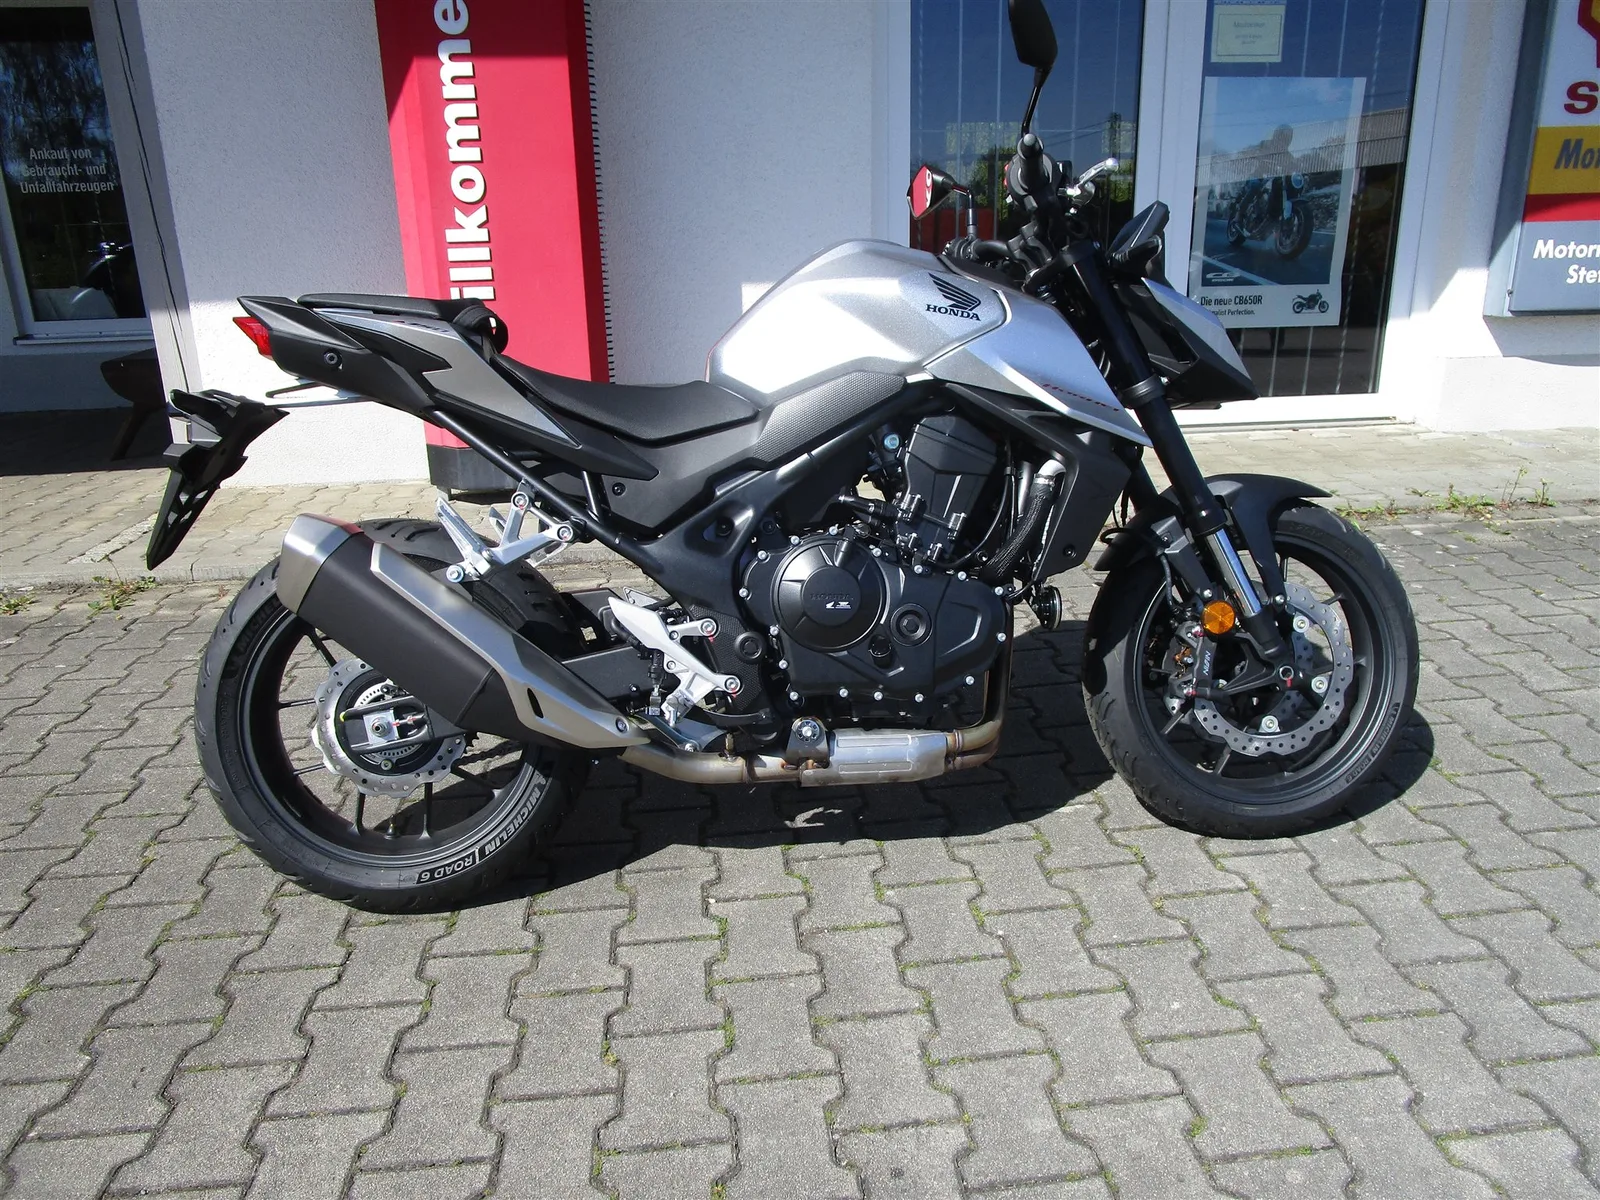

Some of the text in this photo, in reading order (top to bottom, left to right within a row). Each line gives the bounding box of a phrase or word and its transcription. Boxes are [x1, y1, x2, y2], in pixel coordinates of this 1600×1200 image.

[1563, 81, 1599, 114] S
[29, 148, 92, 160] Ankauf von
[434, 0, 496, 301] illkomme
[22, 164, 106, 177] Gebraucht- und
[20, 181, 114, 194] Unfallfahrzeugen
[1566, 264, 1600, 284] Ste
[1200, 295, 1263, 306] Die neue CB650R
[926, 303, 982, 321] HONDA
[420, 786, 541, 882] MICHELIN ROAD 6
